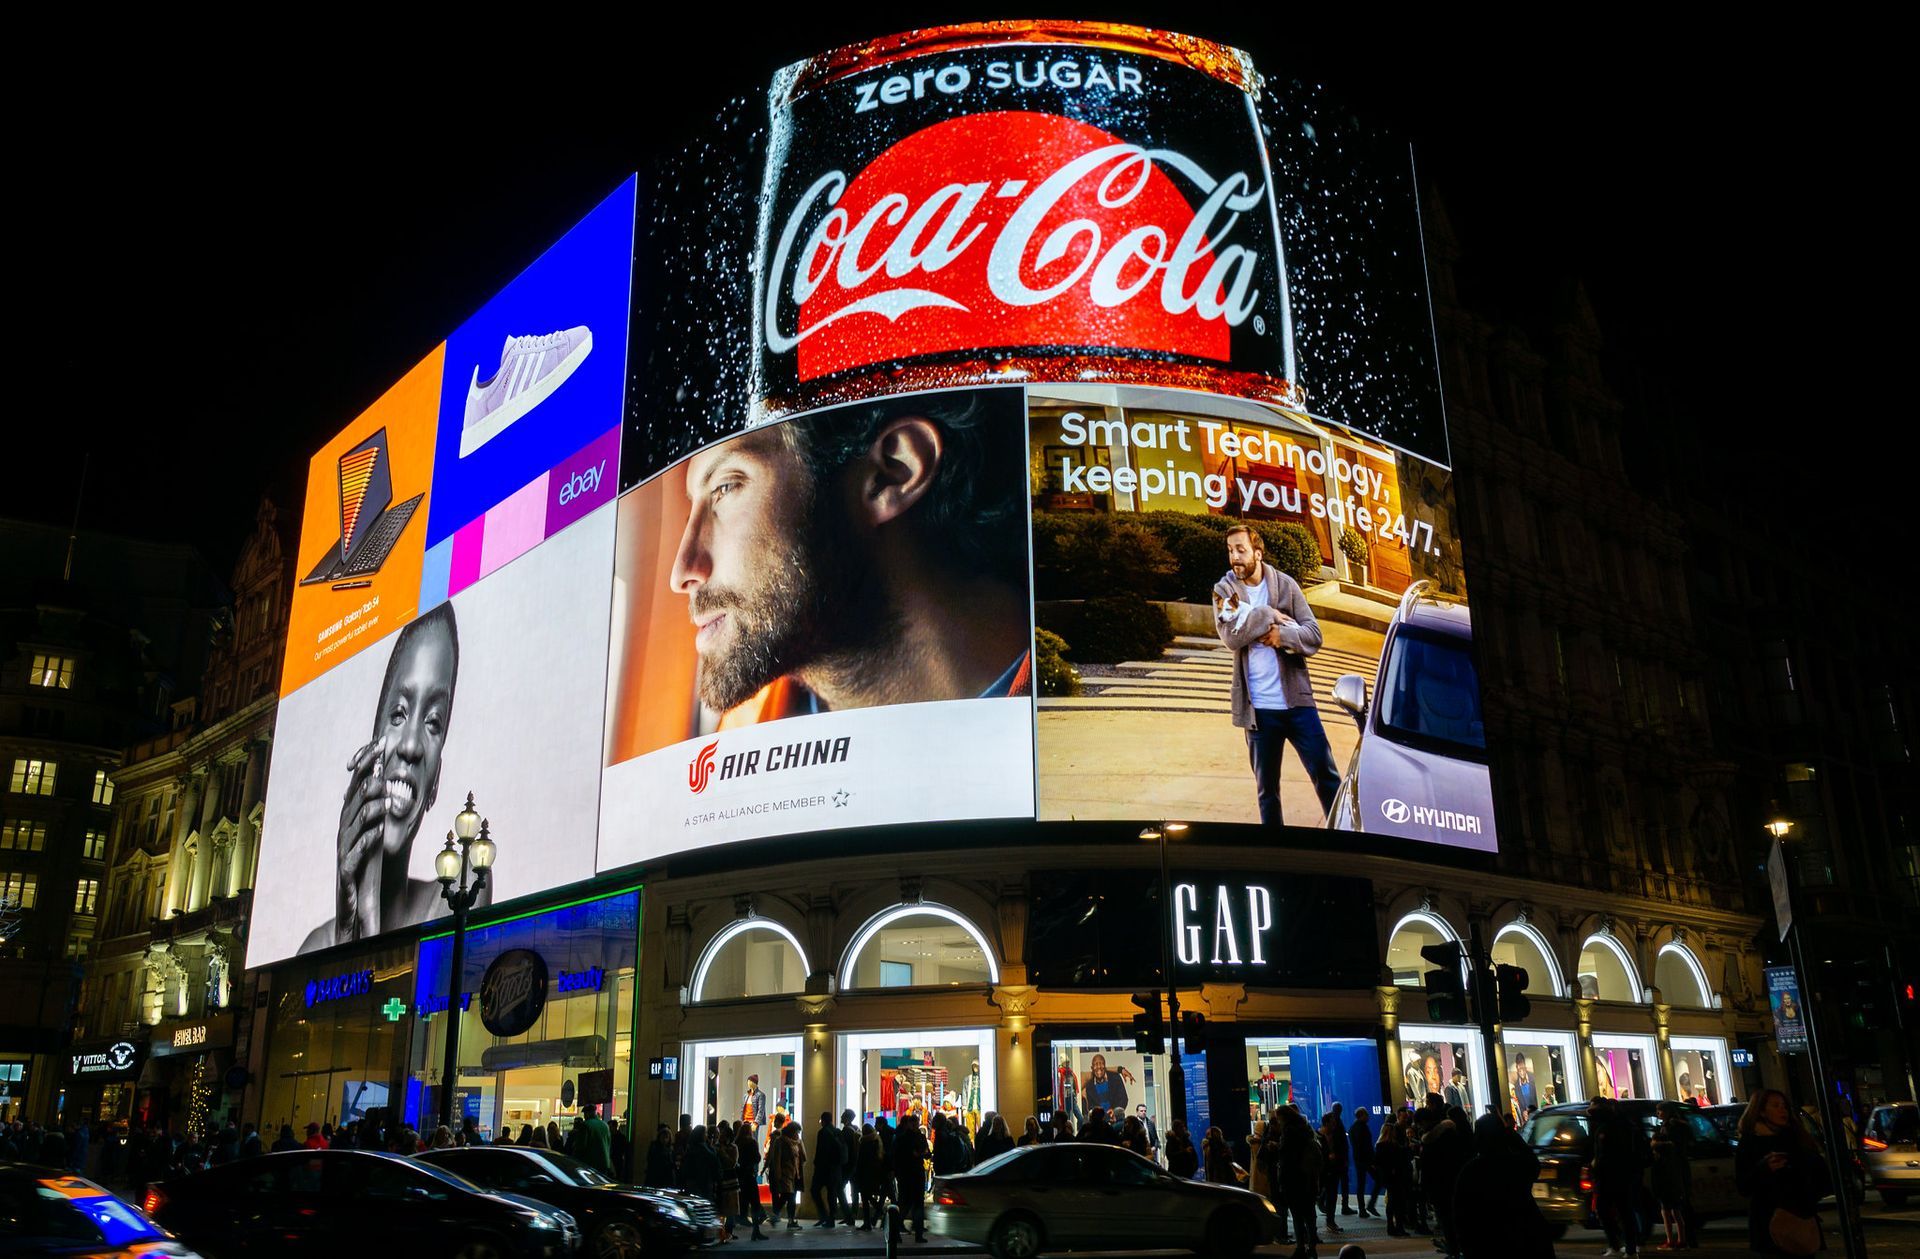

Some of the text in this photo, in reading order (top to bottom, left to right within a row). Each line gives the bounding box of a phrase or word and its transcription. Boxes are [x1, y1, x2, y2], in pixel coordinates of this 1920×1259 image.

[855, 60, 1144, 113] zero SUGAR
[765, 143, 1266, 354] Coca-Cola
[1060, 412, 1390, 503] Smart Technology,
[559, 459, 606, 506] ebay
[1063, 457, 1441, 557] keeping you safe 24/7.
[318, 595, 379, 644] SAMSUNG Galaxy Tab S4
[720, 737, 851, 780] AIR CHINA
[684, 795, 826, 827] A STAR ALLIANCE MEMBER
[1414, 806, 1481, 834] HYUNDAI
[1174, 883, 1272, 965] GAP
[317, 970, 371, 1001] BARCLAYS
[558, 966, 604, 992] beauty
[192, 1025, 207, 1044] BAR
